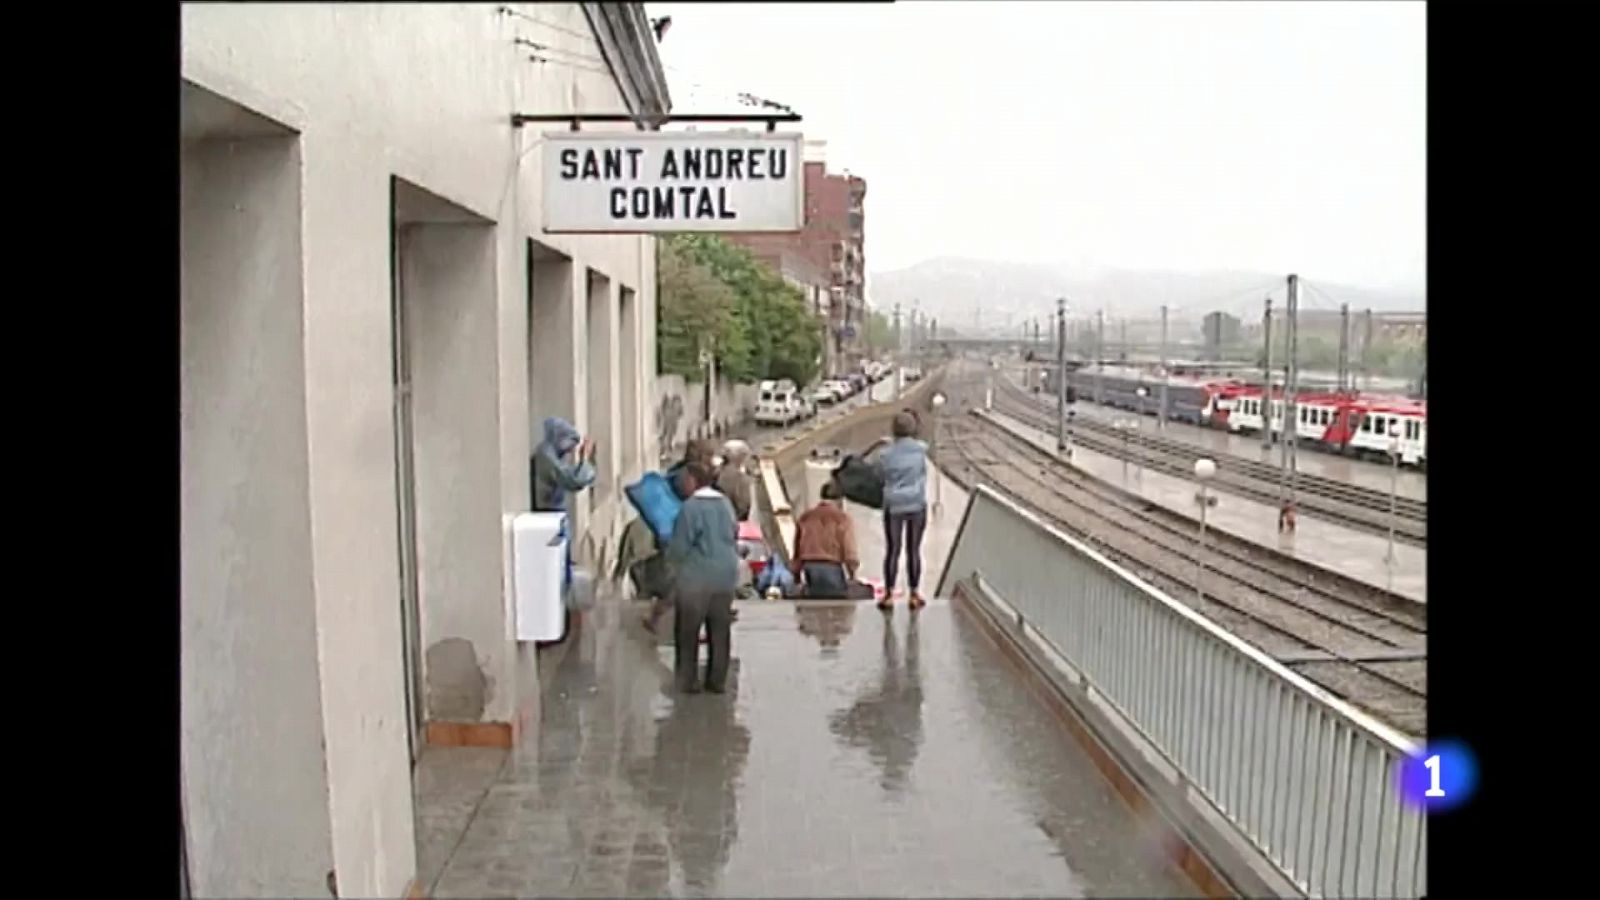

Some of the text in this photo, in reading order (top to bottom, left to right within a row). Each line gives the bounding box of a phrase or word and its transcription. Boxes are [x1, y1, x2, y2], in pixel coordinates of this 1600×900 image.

[560, 148, 787, 180] SANT ANDREU
[609, 186, 736, 219] COMTAL
